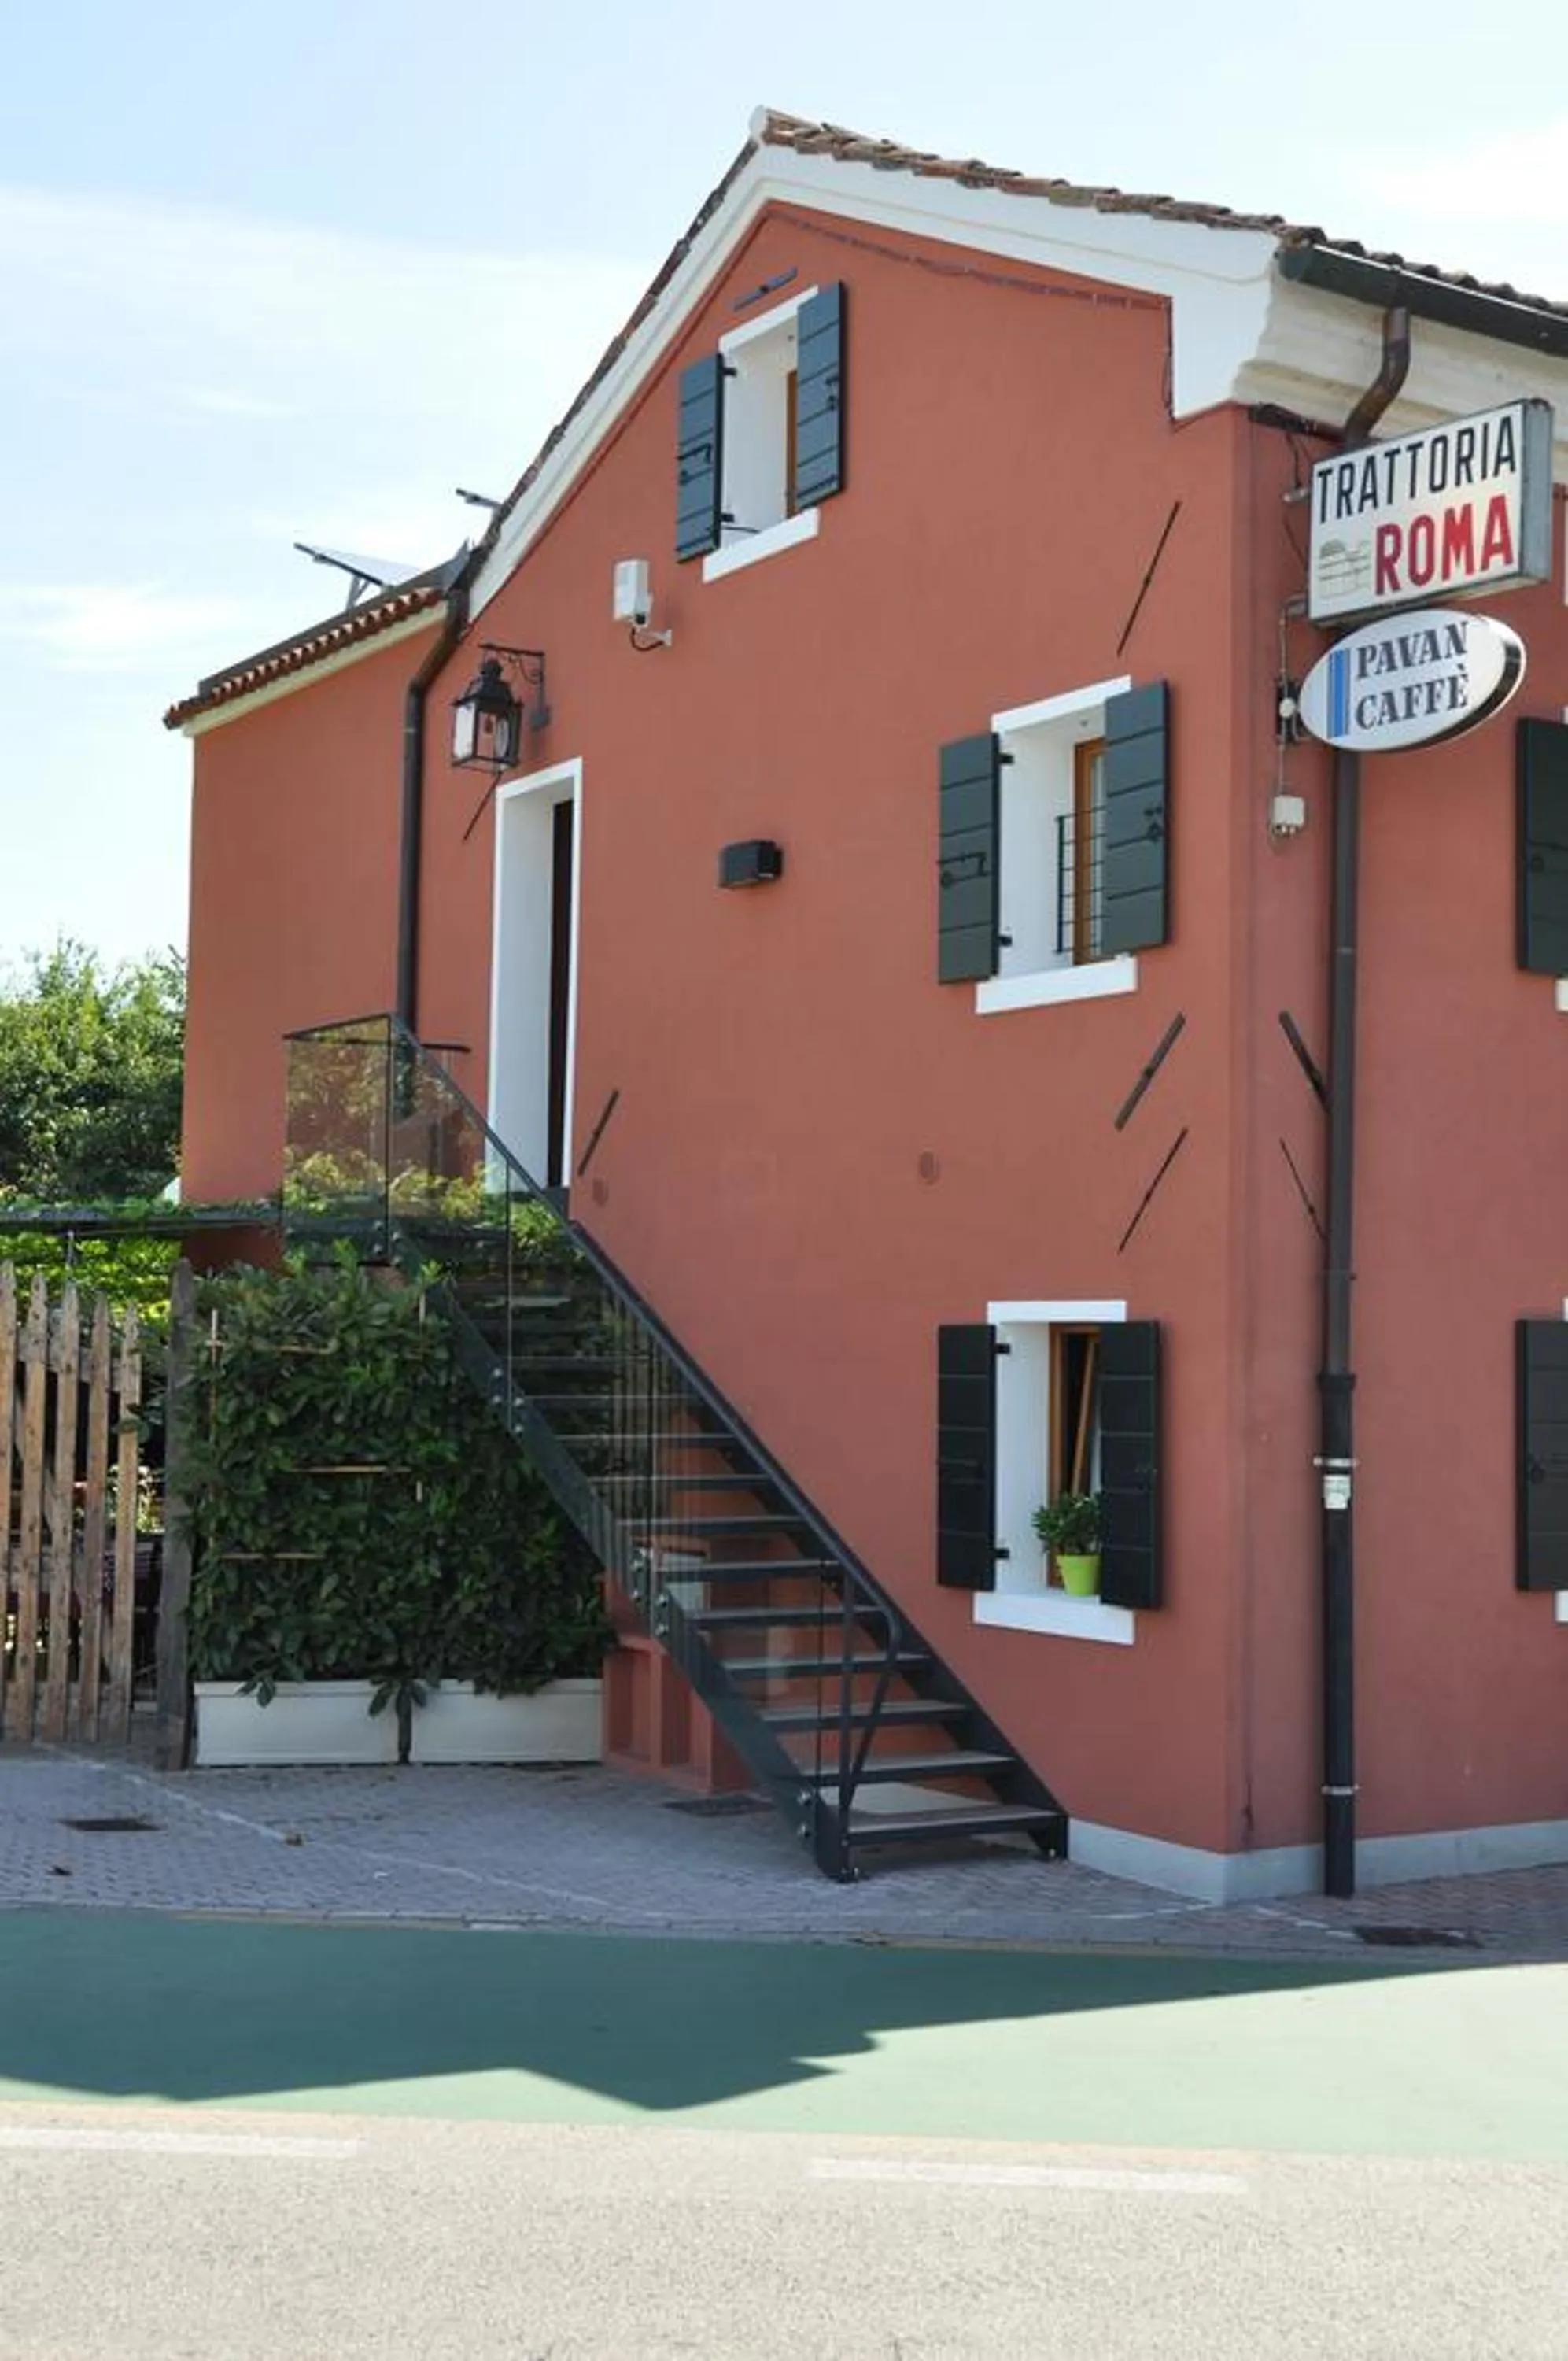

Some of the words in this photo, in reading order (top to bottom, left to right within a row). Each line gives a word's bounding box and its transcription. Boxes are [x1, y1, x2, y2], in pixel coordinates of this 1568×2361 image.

[1317, 416, 1516, 523] TRATTORIA
[1375, 494, 1514, 596] ROMA
[1356, 621, 1469, 678] PAVAN
[1355, 663, 1469, 730] CAFFÈ
